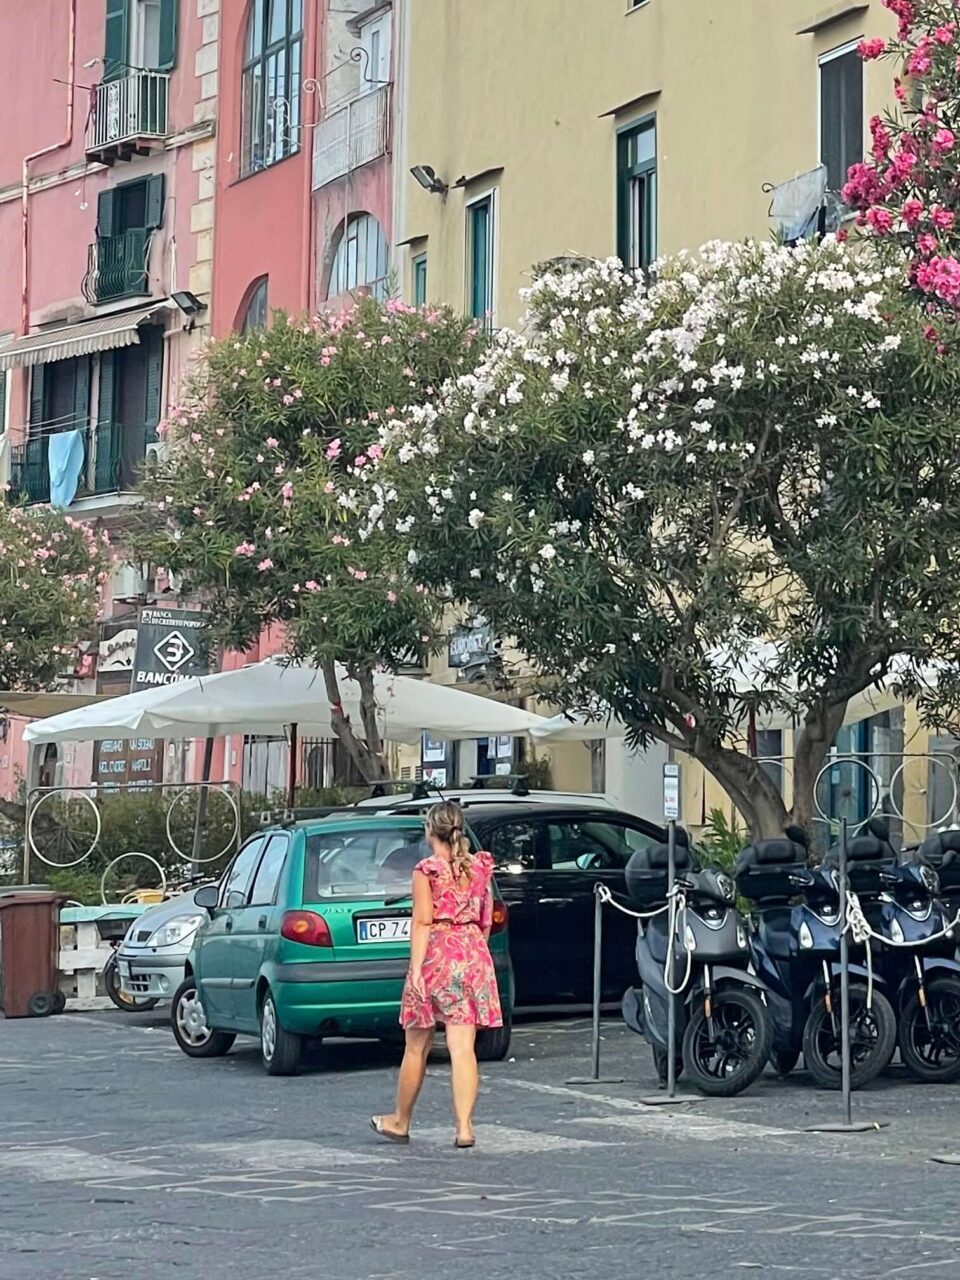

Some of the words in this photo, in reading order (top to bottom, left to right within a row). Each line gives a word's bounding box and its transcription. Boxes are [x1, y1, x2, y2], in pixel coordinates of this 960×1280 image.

[153, 610, 172, 618] BANCA
[159, 618, 183, 627] CREDITO
[369, 922, 386, 938] CP
[391, 921, 409, 937] 74
